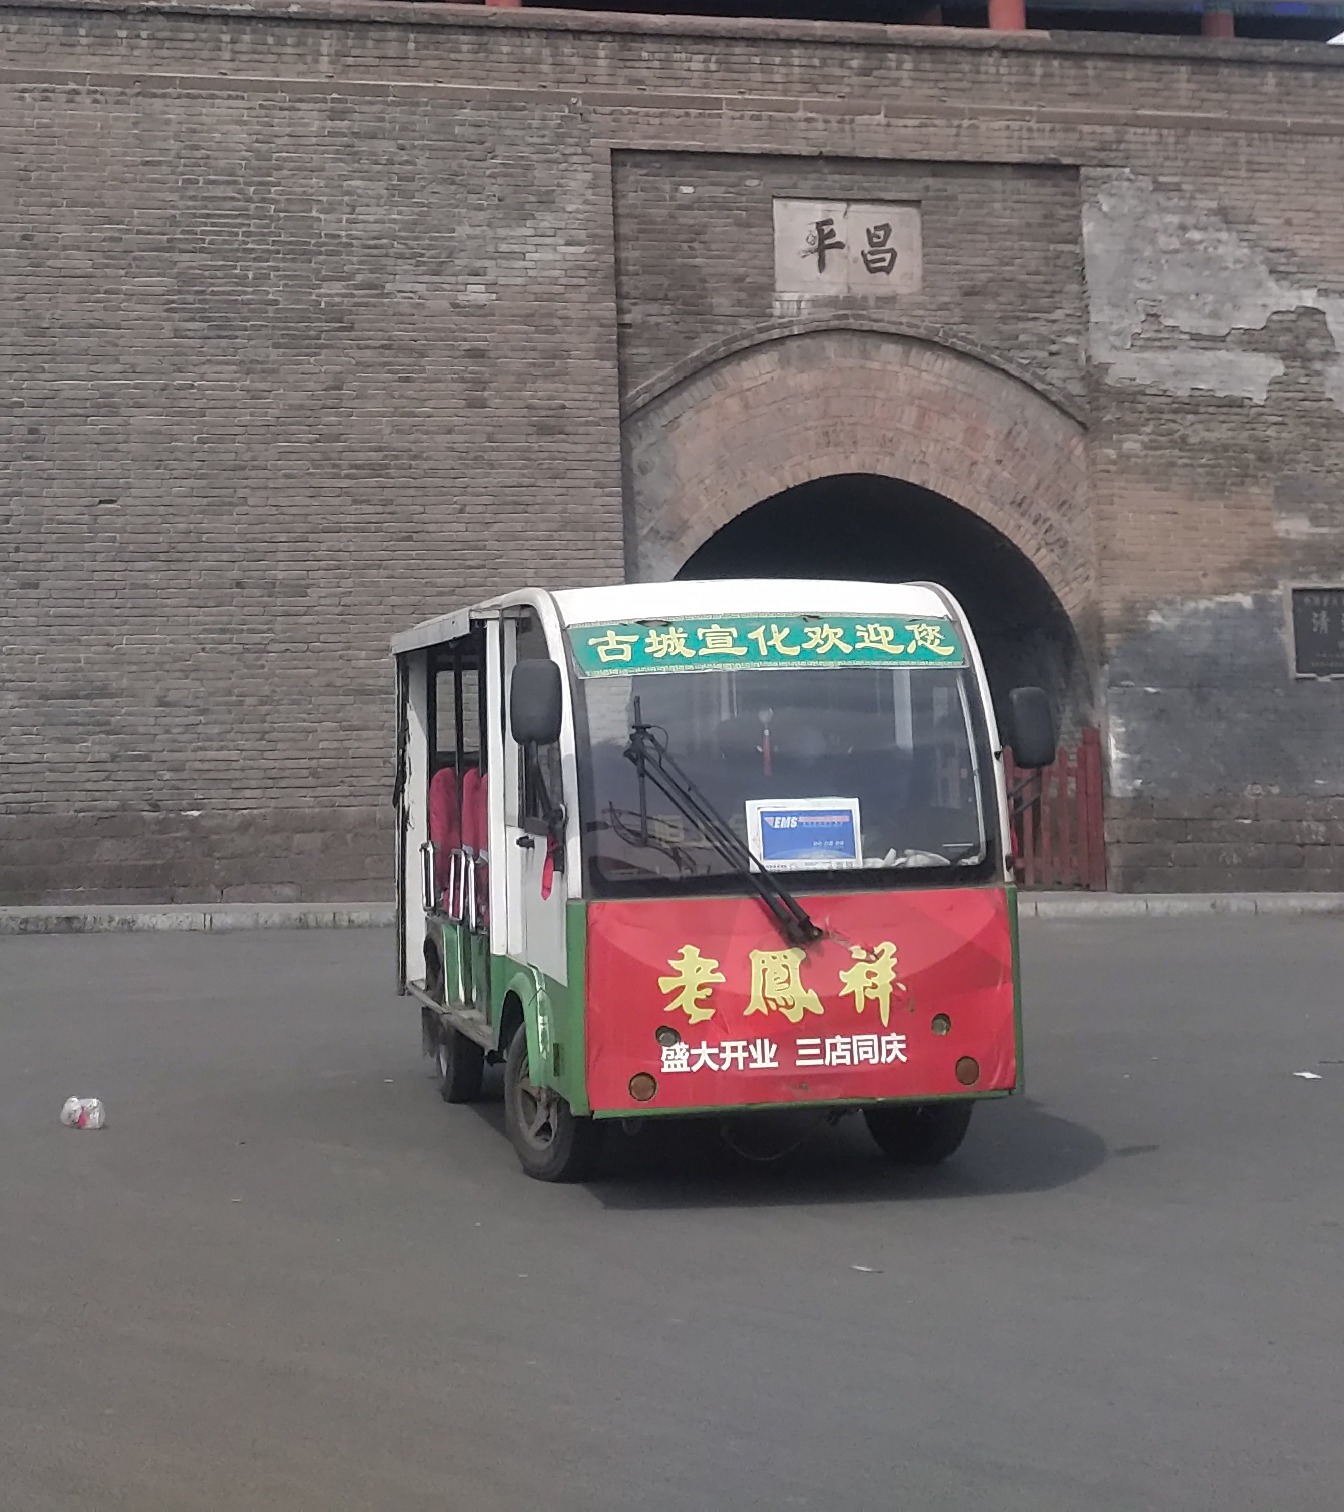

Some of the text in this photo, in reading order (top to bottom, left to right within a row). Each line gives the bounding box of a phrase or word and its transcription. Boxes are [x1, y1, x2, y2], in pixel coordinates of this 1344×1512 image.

[587, 623, 955, 663] 古城宣化欢迎您
[773, 816, 798, 828] EMS
[660, 1032, 908, 1073] 盛大开业 三店同庆
